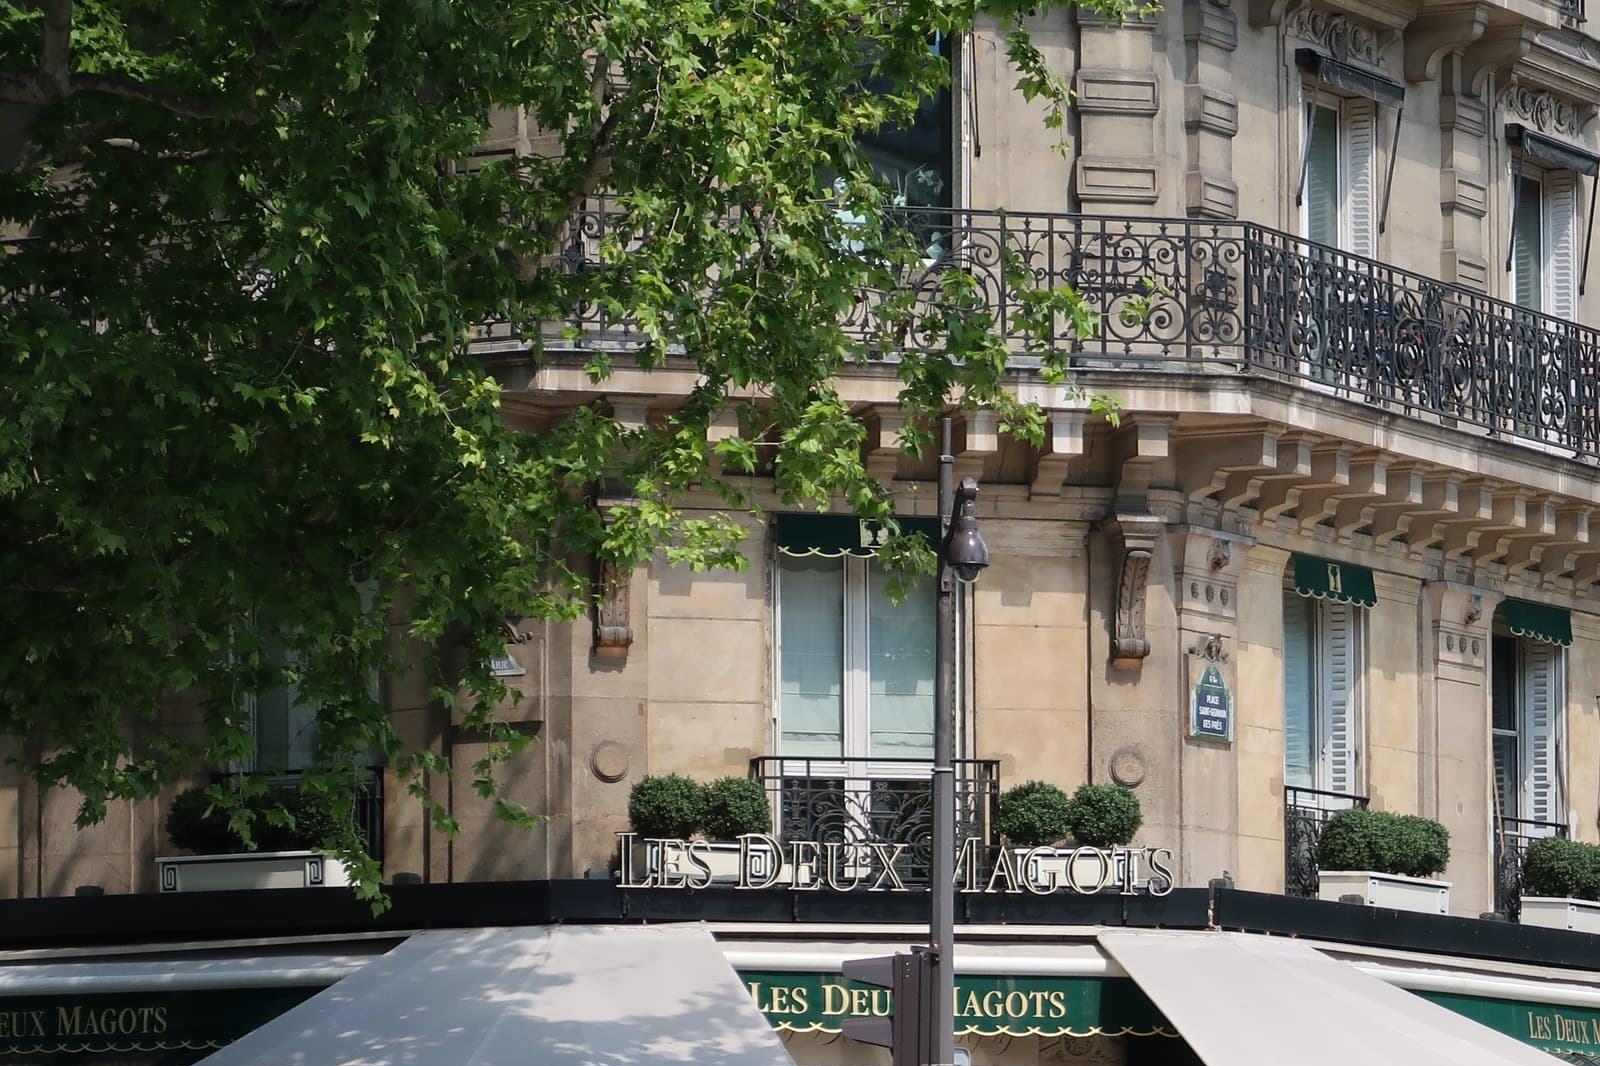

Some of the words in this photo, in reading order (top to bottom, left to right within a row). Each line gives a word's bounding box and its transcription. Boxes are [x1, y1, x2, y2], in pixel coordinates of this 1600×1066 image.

[615, 831, 715, 889] LES
[734, 832, 910, 893] DEUX
[748, 982, 810, 1014] LES
[821, 984, 892, 1018] DEU
[953, 985, 1067, 1019] AGOTS
[0, 1009, 47, 1038] EUX
[56, 1005, 168, 1037] MAGOTS
[1527, 1011, 1552, 1041] LES
[1554, 1013, 1591, 1045] DEUX
